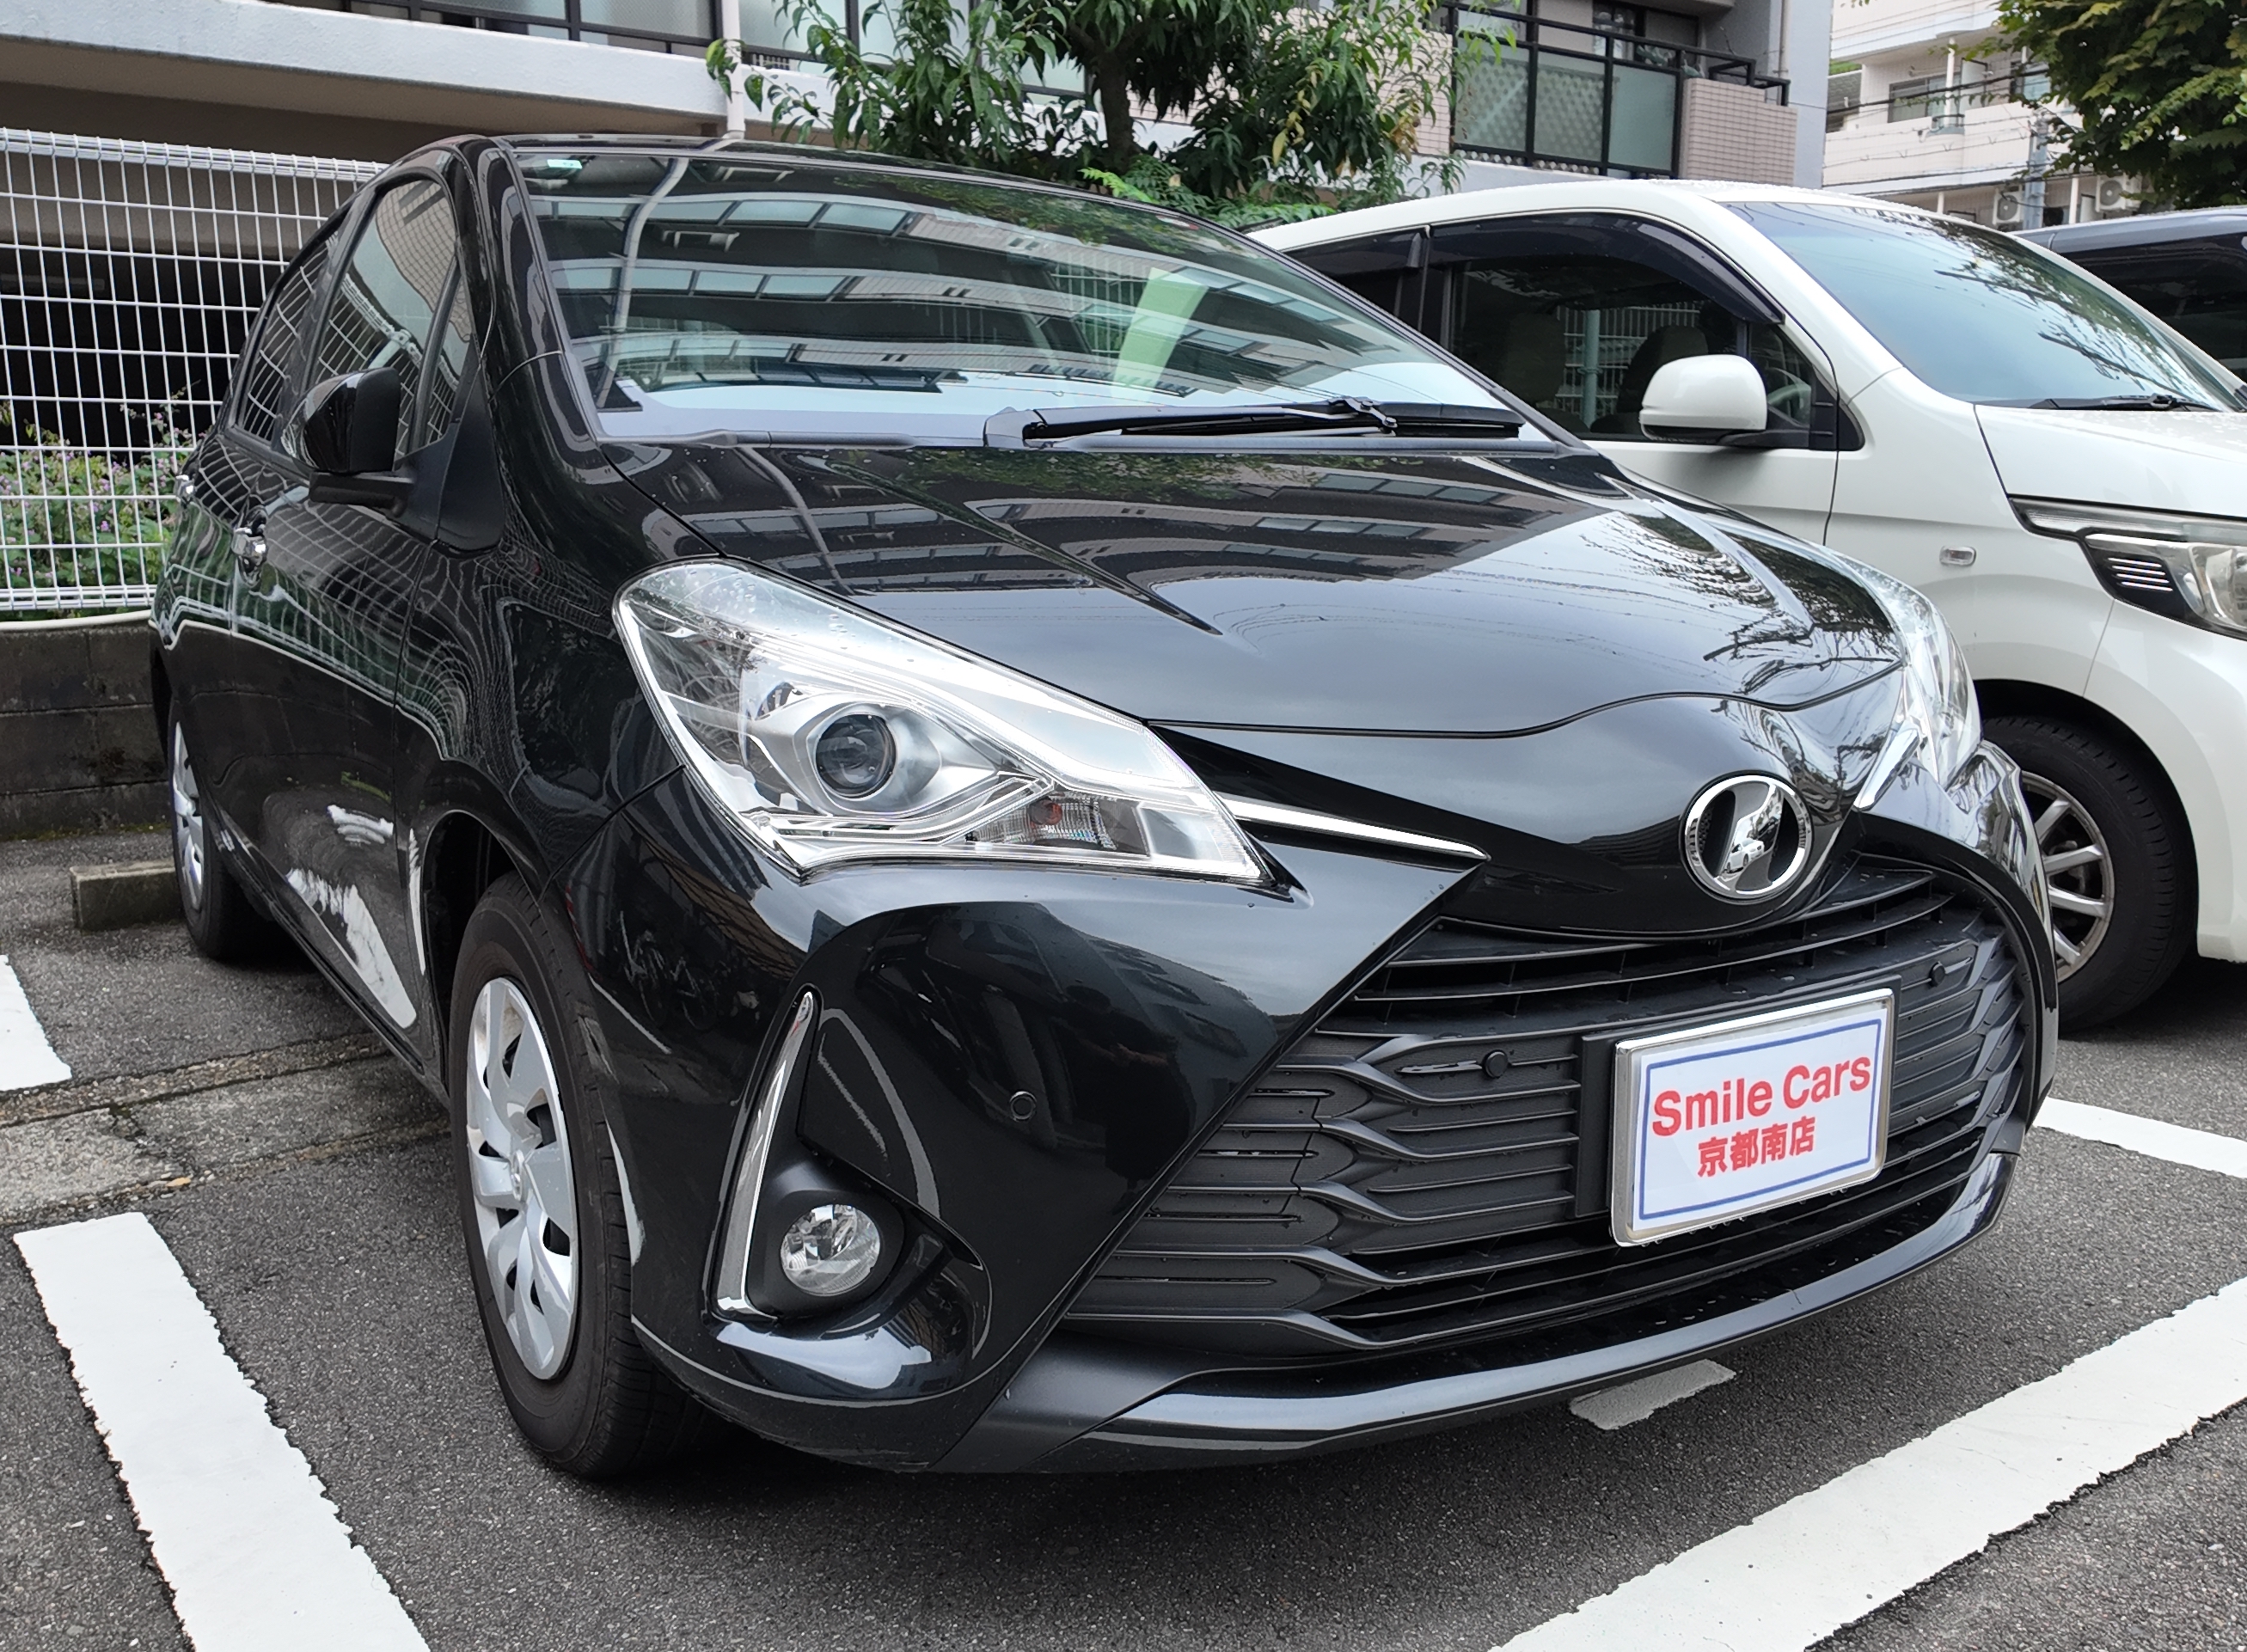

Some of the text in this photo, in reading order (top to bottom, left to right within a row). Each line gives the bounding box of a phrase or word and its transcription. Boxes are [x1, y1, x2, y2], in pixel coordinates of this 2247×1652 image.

[1651, 1056, 1871, 1137] Smile Cars
[1697, 1115, 1816, 1178] 京都南店
